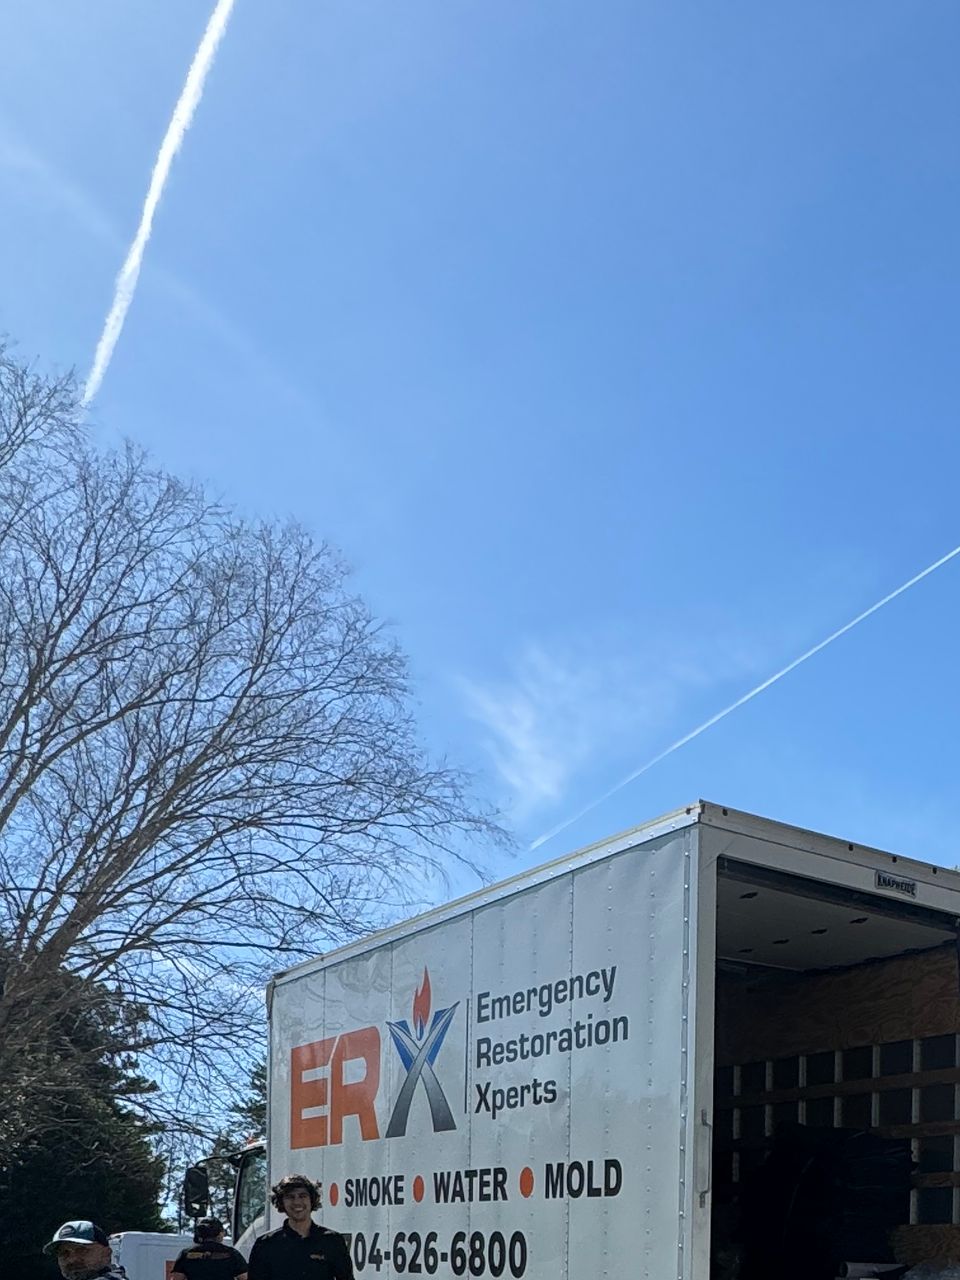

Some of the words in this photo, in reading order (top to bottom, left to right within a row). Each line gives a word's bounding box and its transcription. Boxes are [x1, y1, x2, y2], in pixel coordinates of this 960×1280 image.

[476, 965, 618, 1024] Emergency
[476, 1014, 629, 1068] Restoration
[474, 1078, 558, 1120] Xperts
[345, 1175, 405, 1207] SMOKE
[433, 1167, 508, 1203] WATER
[545, 1159, 622, 1199] MOLD
